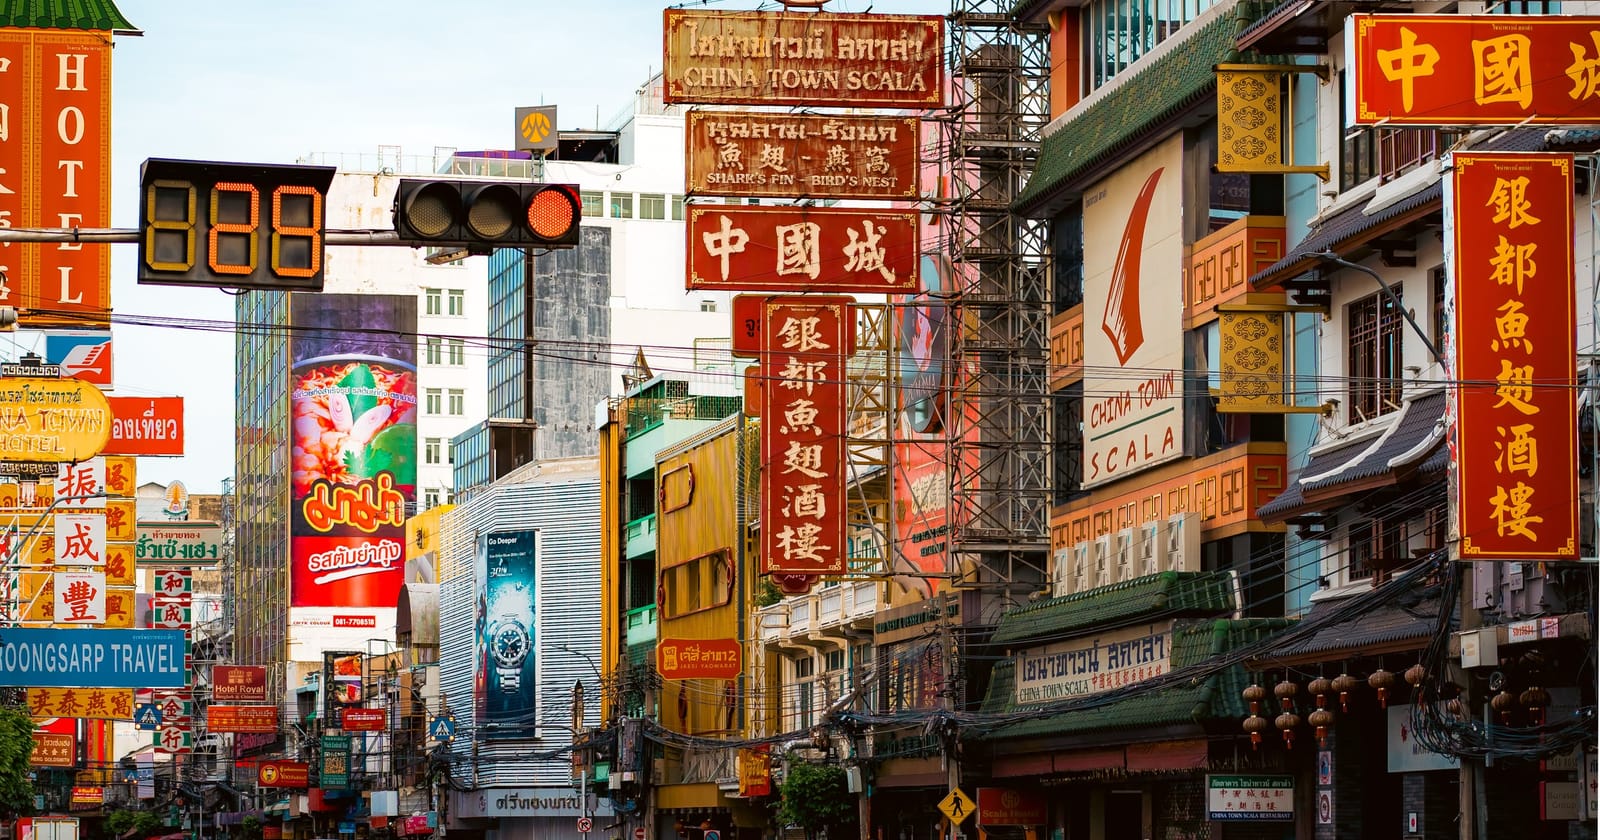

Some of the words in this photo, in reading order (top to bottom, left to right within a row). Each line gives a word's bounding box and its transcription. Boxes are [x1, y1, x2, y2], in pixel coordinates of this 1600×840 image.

[684, 21, 825, 59] ไชน่าทาวน์
[683, 67, 759, 88] CHINA
[767, 68, 839, 90] TOWN
[847, 71, 926, 92] SCALA
[55, 53, 89, 304] HOTEL
[706, 173, 766, 185] SHARK'S
[771, 175, 794, 185] FIN
[811, 175, 858, 187] BIRD'S
[863, 177, 898, 188] NEST
[702, 214, 896, 284] 中國城
[1485, 176, 1543, 542] 銀都魚翅酒樓
[1090, 390, 1132, 430] CHINA
[1137, 368, 1175, 407] TOWN
[776, 316, 831, 563] 銀都魚翅酒樓
[1090, 426, 1174, 480] SCALA
[304, 474, 404, 532] มาม่า
[309, 539, 402, 571] รสต้มยำกุ้ง
[498, 537, 518, 545] Deeper
[0, 642, 104, 673] OONGSARP
[112, 644, 178, 673] TRAVEL
[215, 685, 238, 693] Hotel
[240, 685, 264, 695] Royal
[1019, 687, 1040, 702] CHINA
[1042, 684, 1064, 699] TOWN
[1065, 680, 1089, 696] SCALA
